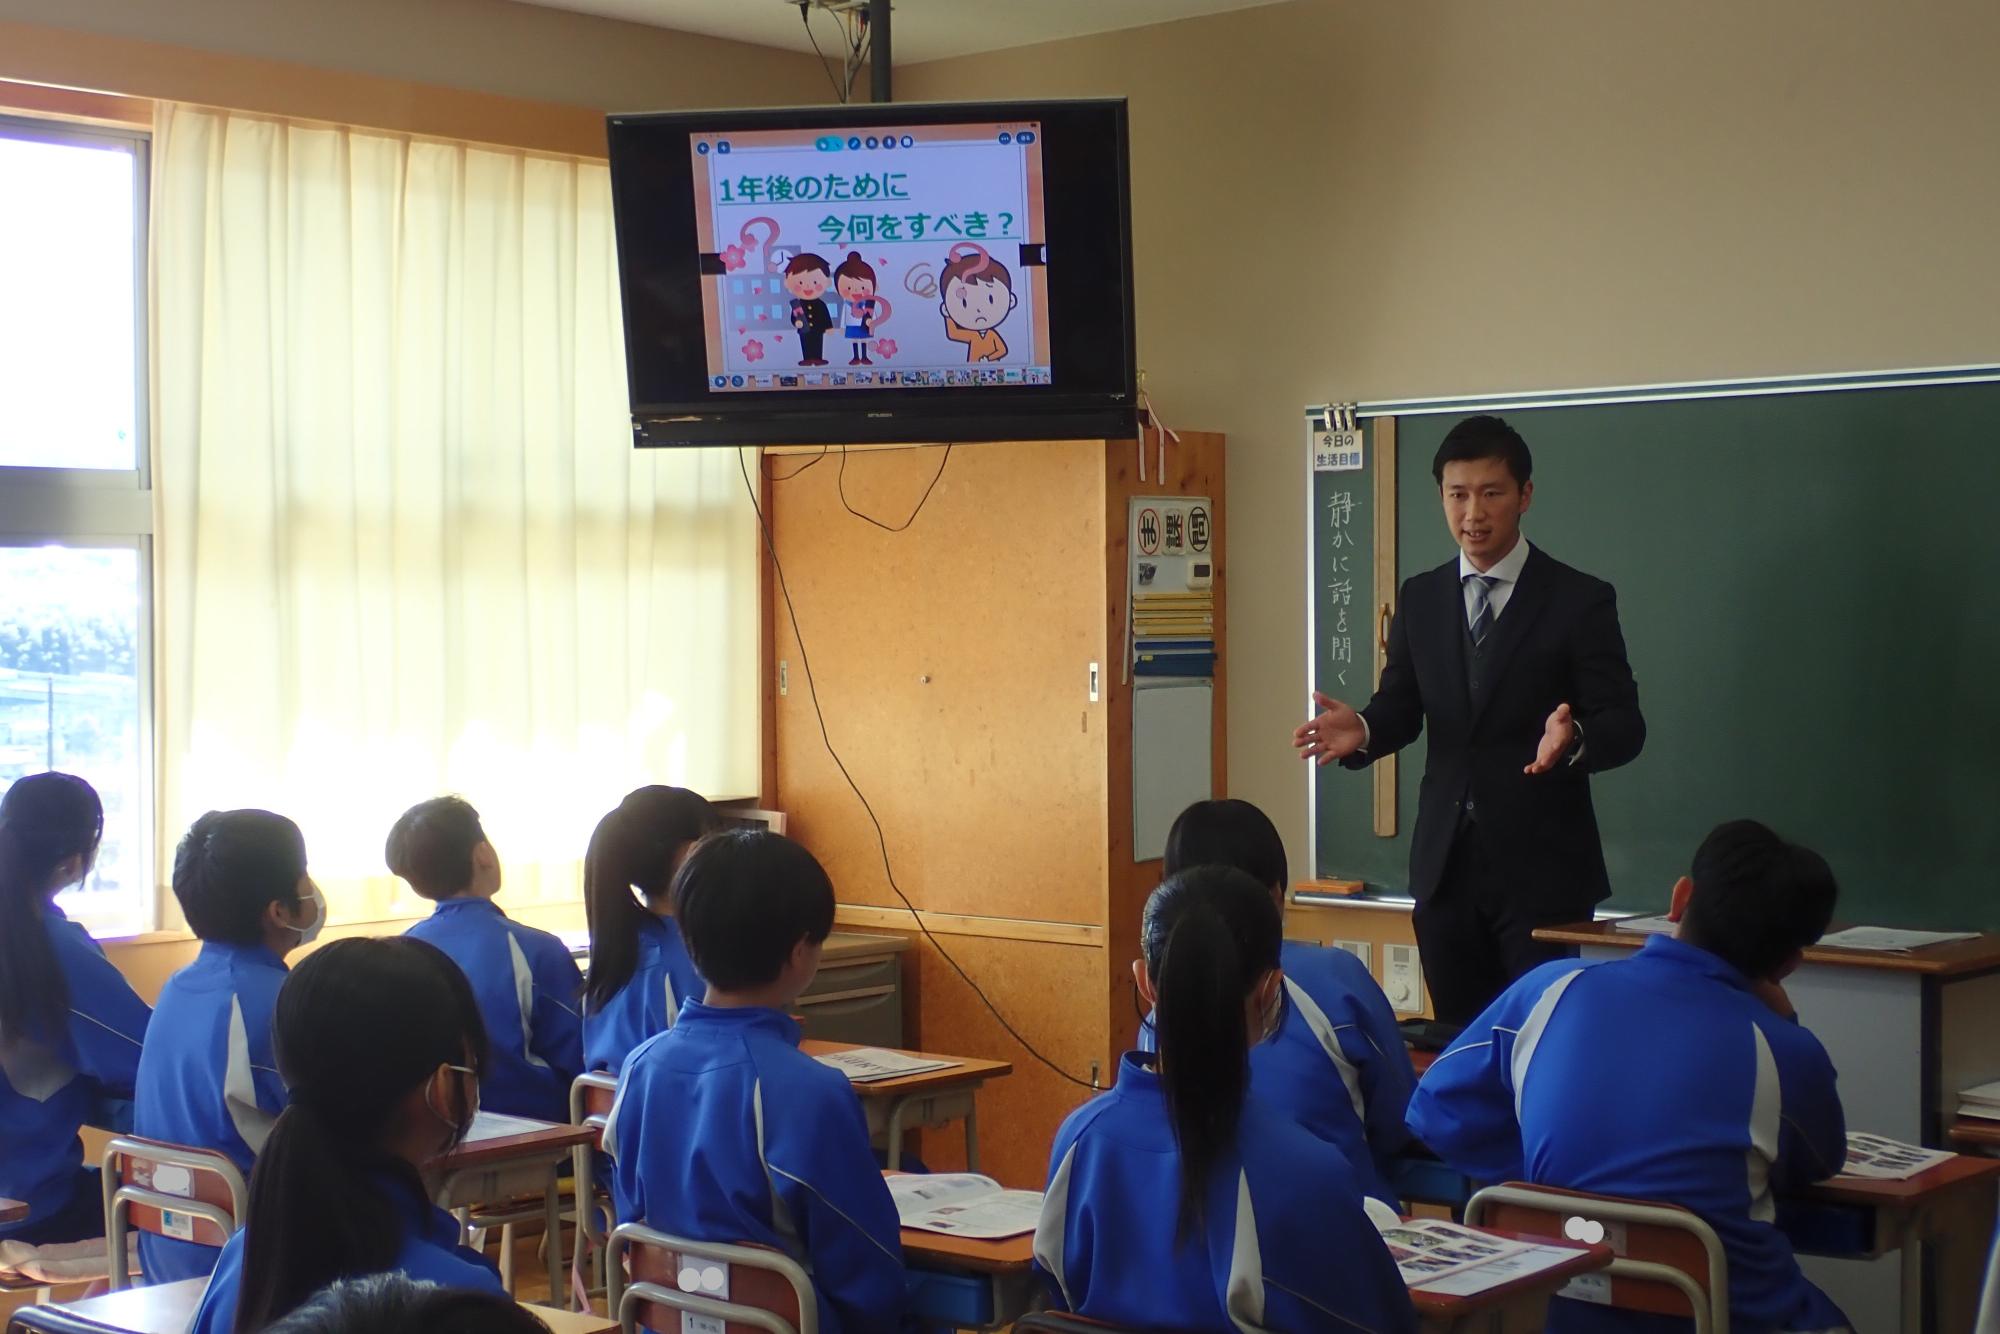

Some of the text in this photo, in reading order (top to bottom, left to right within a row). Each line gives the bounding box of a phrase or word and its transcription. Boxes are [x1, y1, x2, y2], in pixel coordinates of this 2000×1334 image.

[720, 172, 908, 202] 1年後のために
[818, 211, 1013, 242] 今何をすべき？
[1323, 434, 1354, 447] 今日の
[1328, 491, 1362, 686] 静かに話を聞く
